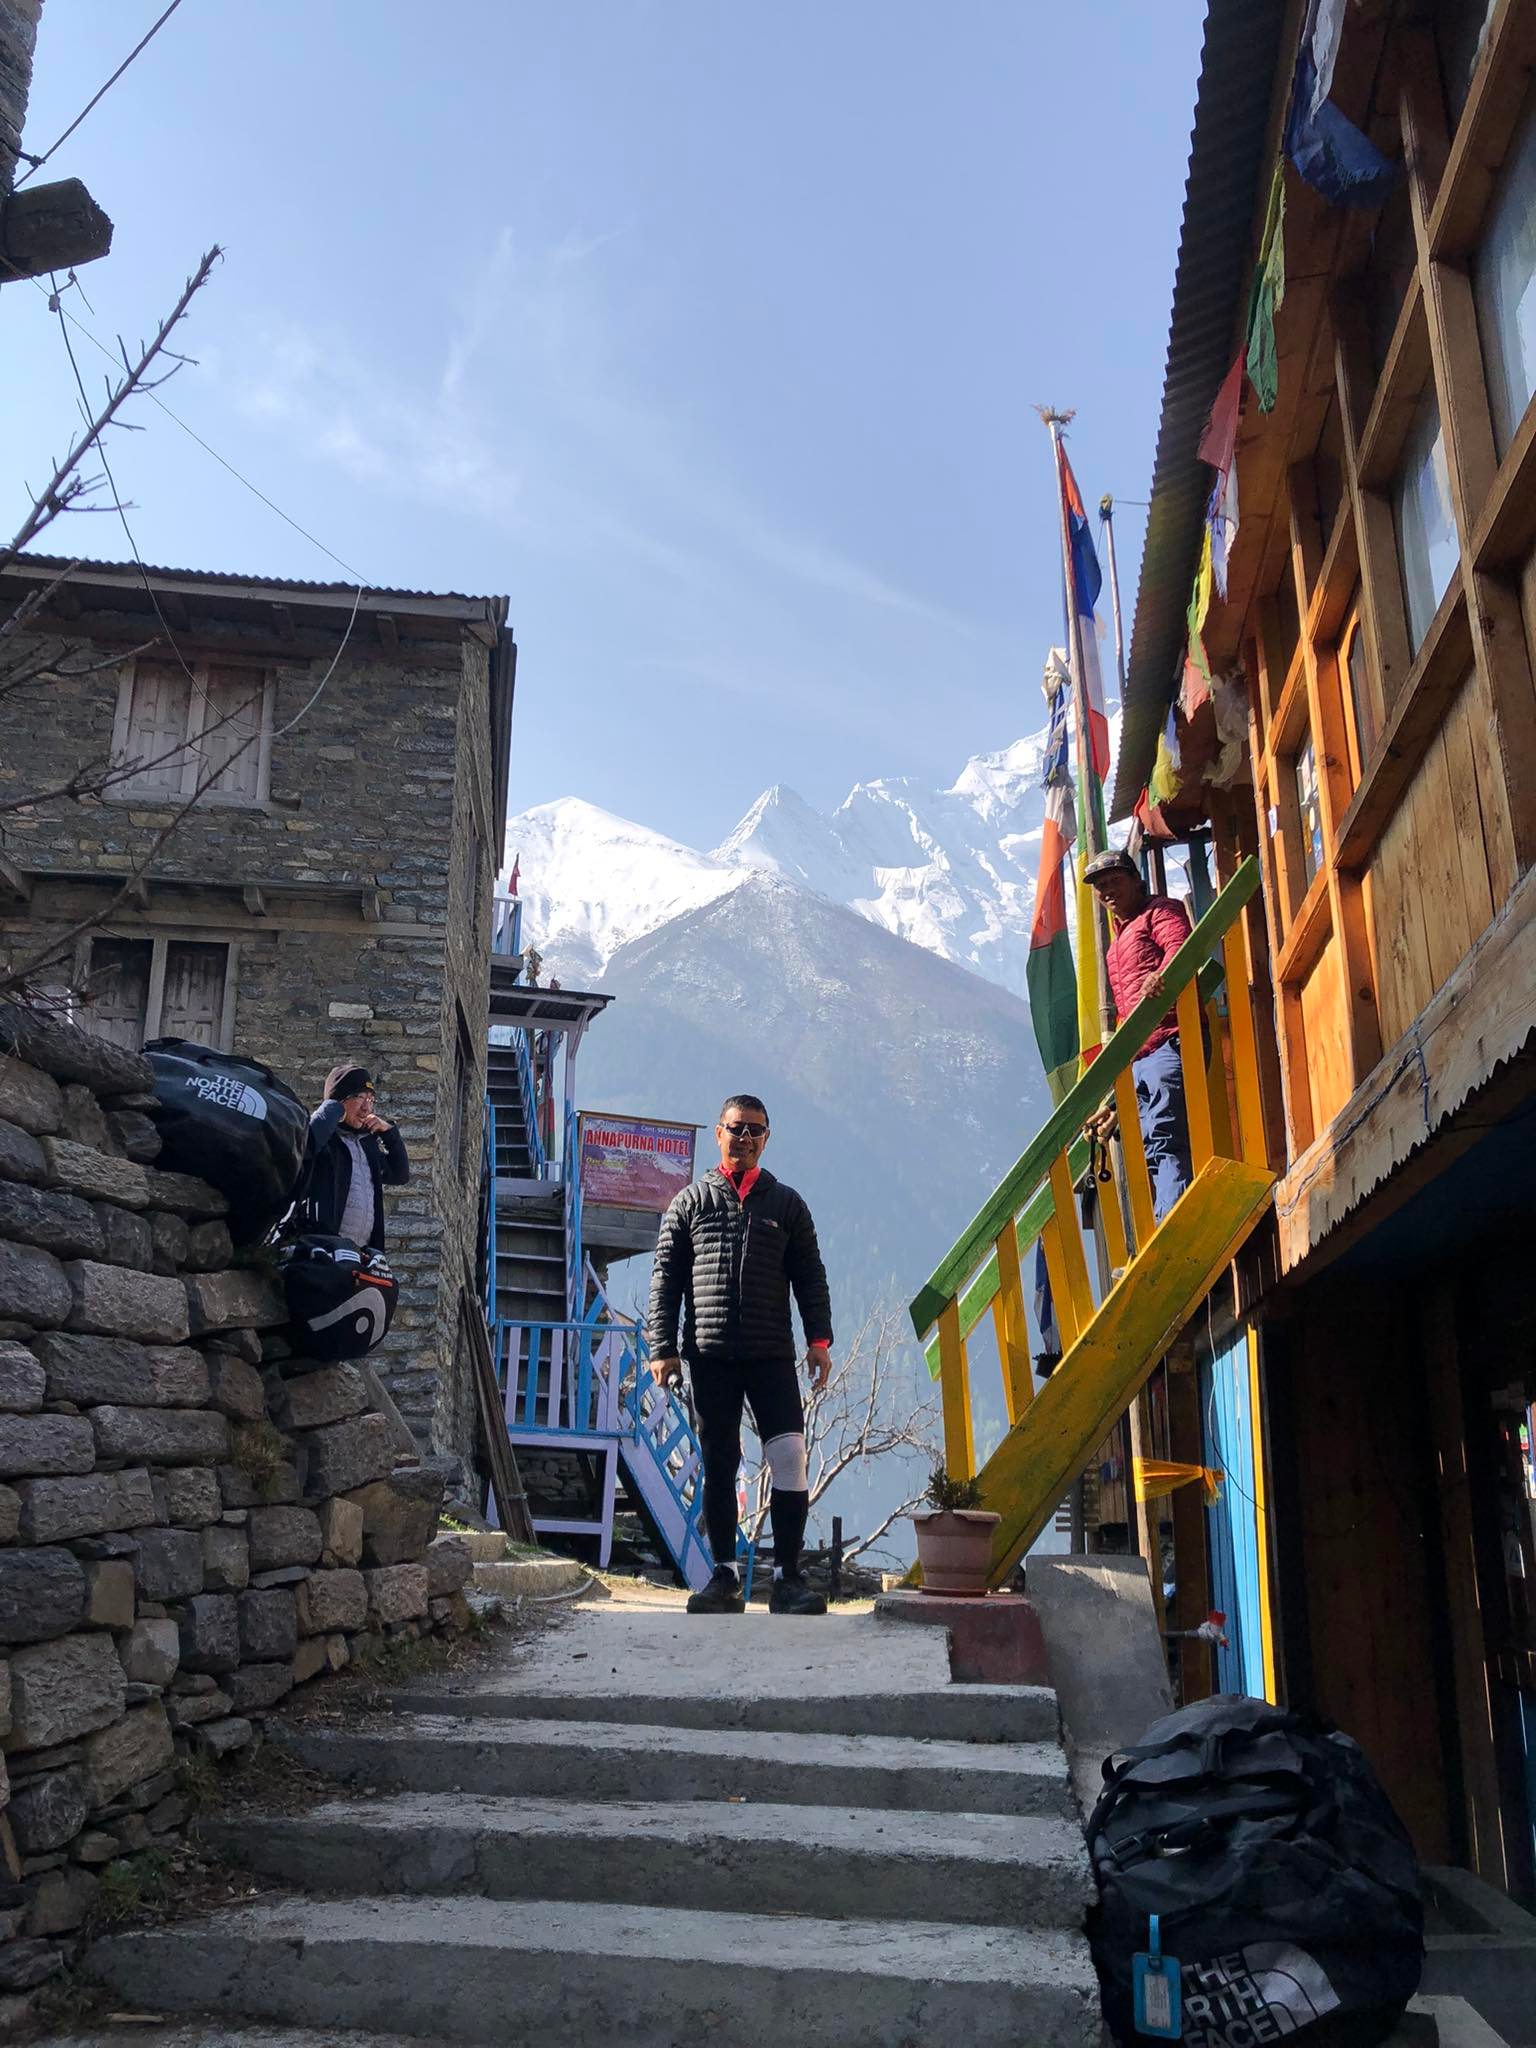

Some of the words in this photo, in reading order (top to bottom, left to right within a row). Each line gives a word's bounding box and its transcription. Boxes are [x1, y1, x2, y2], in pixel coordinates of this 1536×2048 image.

[185, 1077, 241, 1100] NORTH
[214, 1074, 245, 1090] THE
[197, 1088, 238, 1109] FACE
[586, 1129, 654, 1151] ANNAPURNA
[657, 1137, 690, 1156] HOTEL
